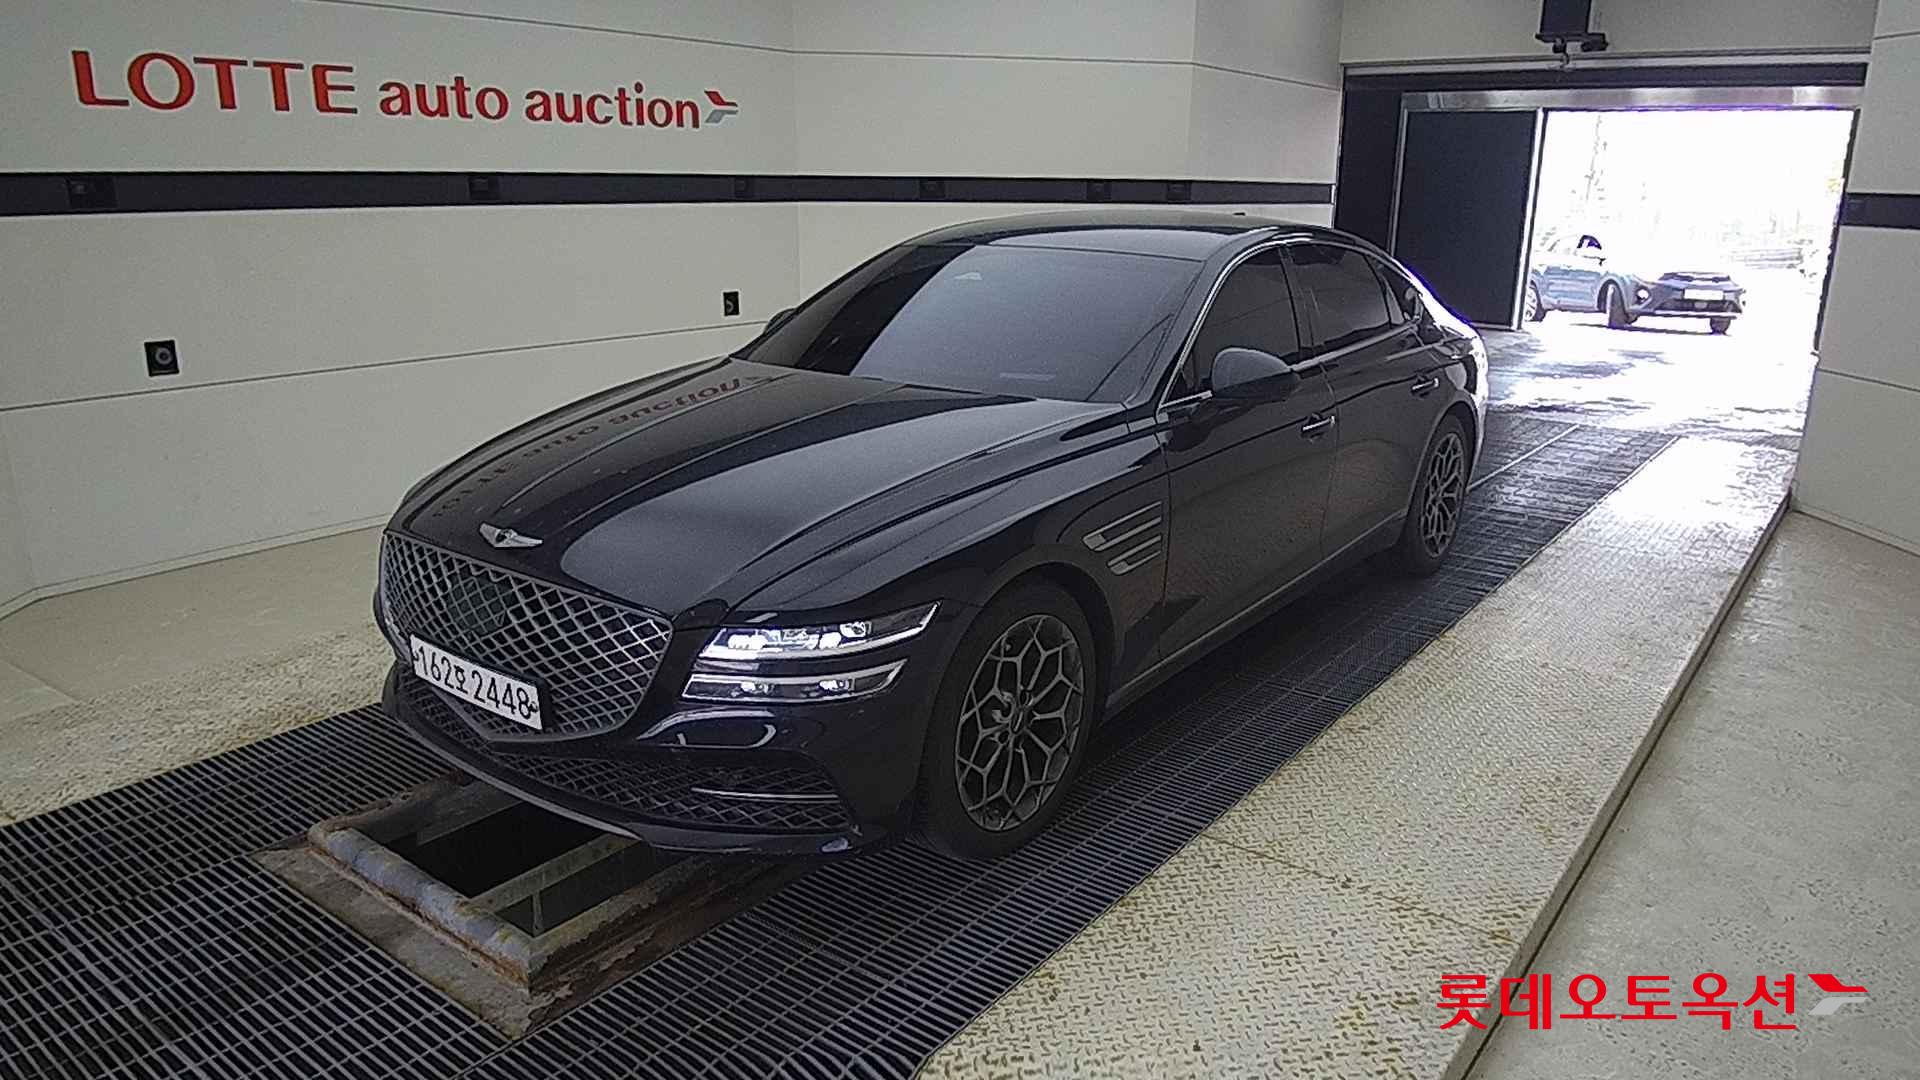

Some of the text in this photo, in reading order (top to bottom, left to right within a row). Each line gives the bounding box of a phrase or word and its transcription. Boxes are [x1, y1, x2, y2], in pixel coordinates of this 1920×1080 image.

[72, 50, 701, 128] LOTTE auto auction
[472, 670, 532, 719] 2448
